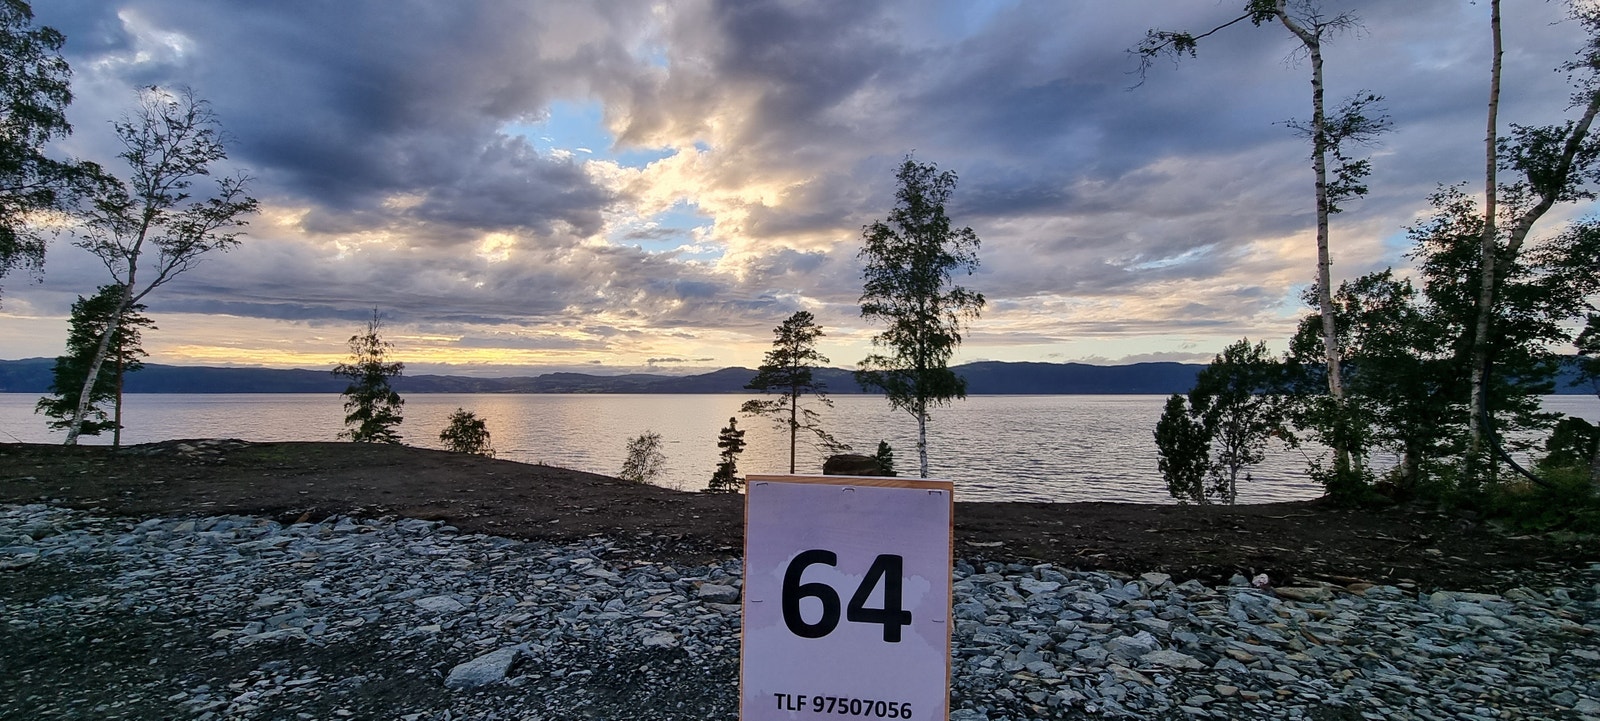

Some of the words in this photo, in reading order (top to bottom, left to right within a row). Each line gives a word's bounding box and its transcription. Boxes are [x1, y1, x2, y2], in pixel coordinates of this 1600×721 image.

[781, 549, 912, 642] 64
[773, 693, 807, 711] TLF
[812, 696, 913, 719] 97507056
